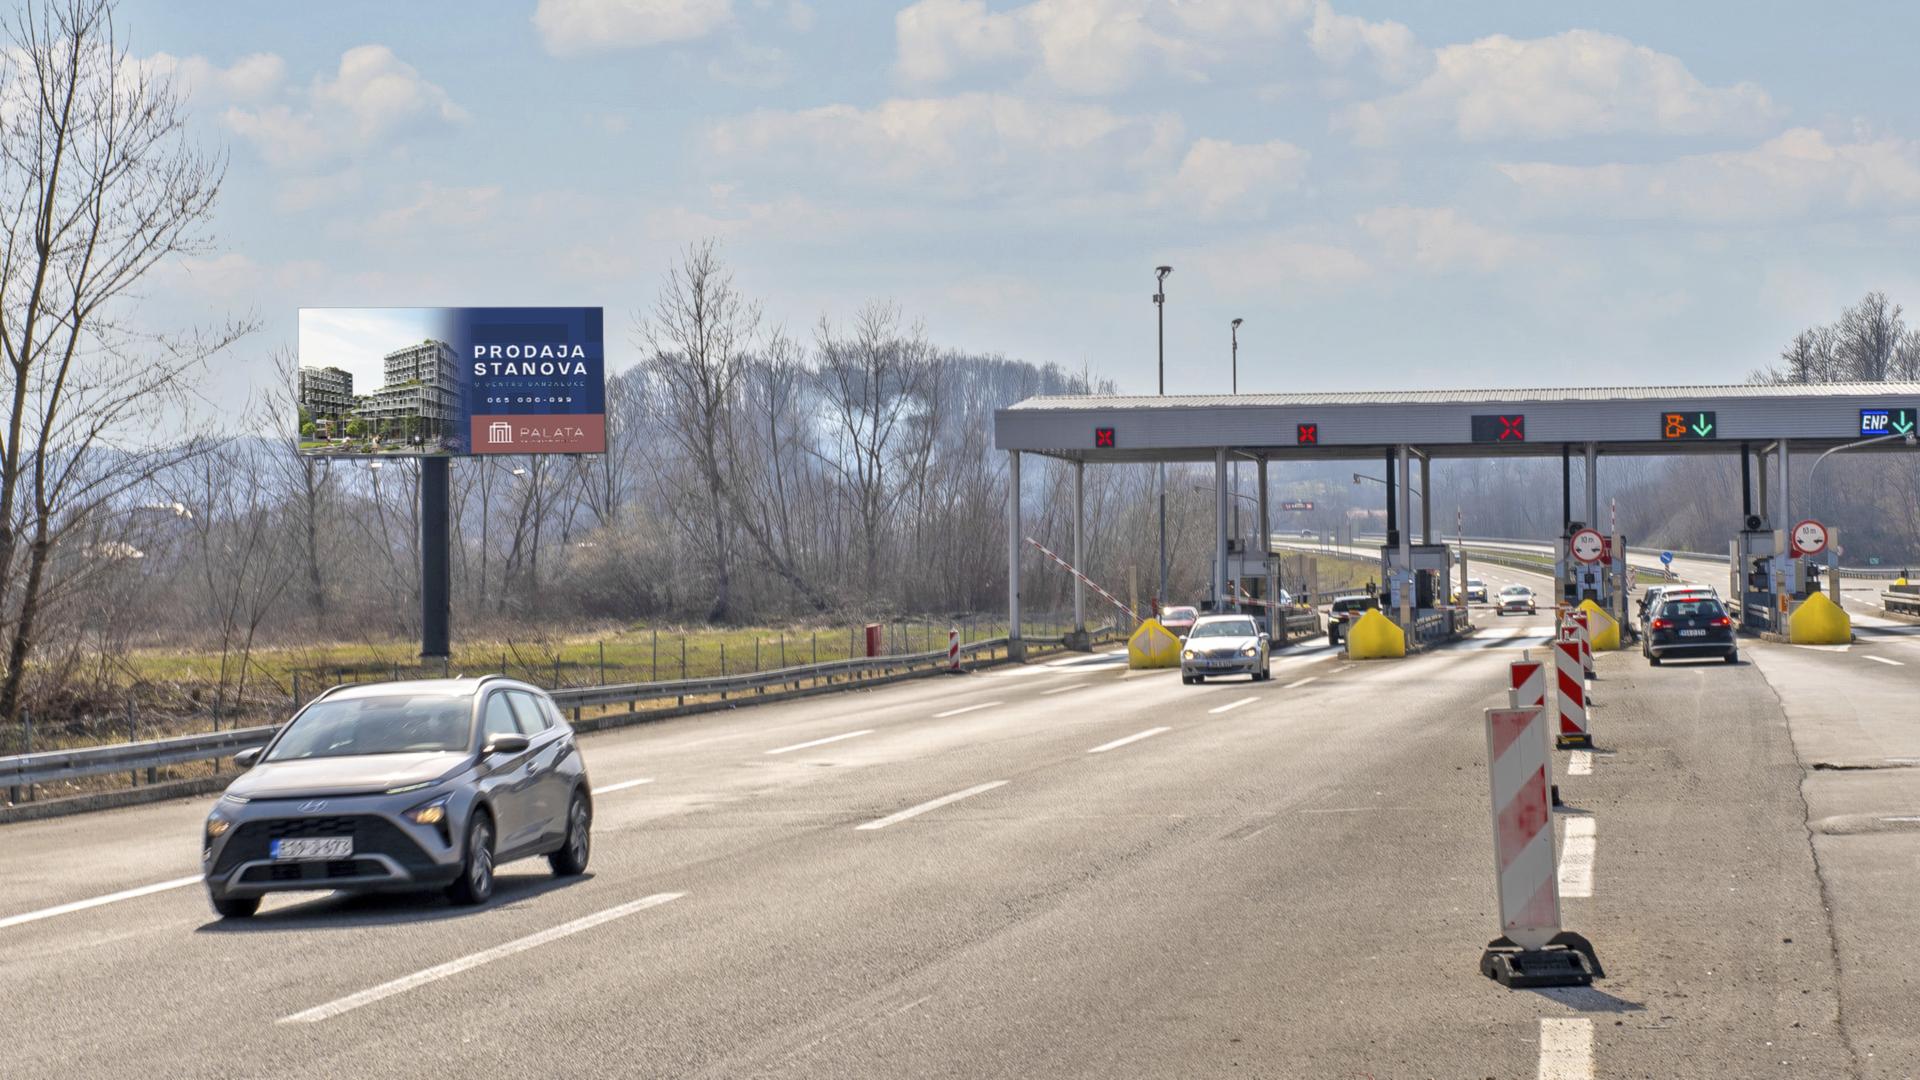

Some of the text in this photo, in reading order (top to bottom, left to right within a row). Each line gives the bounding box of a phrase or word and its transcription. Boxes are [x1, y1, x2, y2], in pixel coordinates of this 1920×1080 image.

[474, 345, 585, 359] PRODAJA
[474, 362, 588, 376] STANOVA
[1862, 415, 1889, 430] ENP
[520, 427, 585, 438] PALATA
